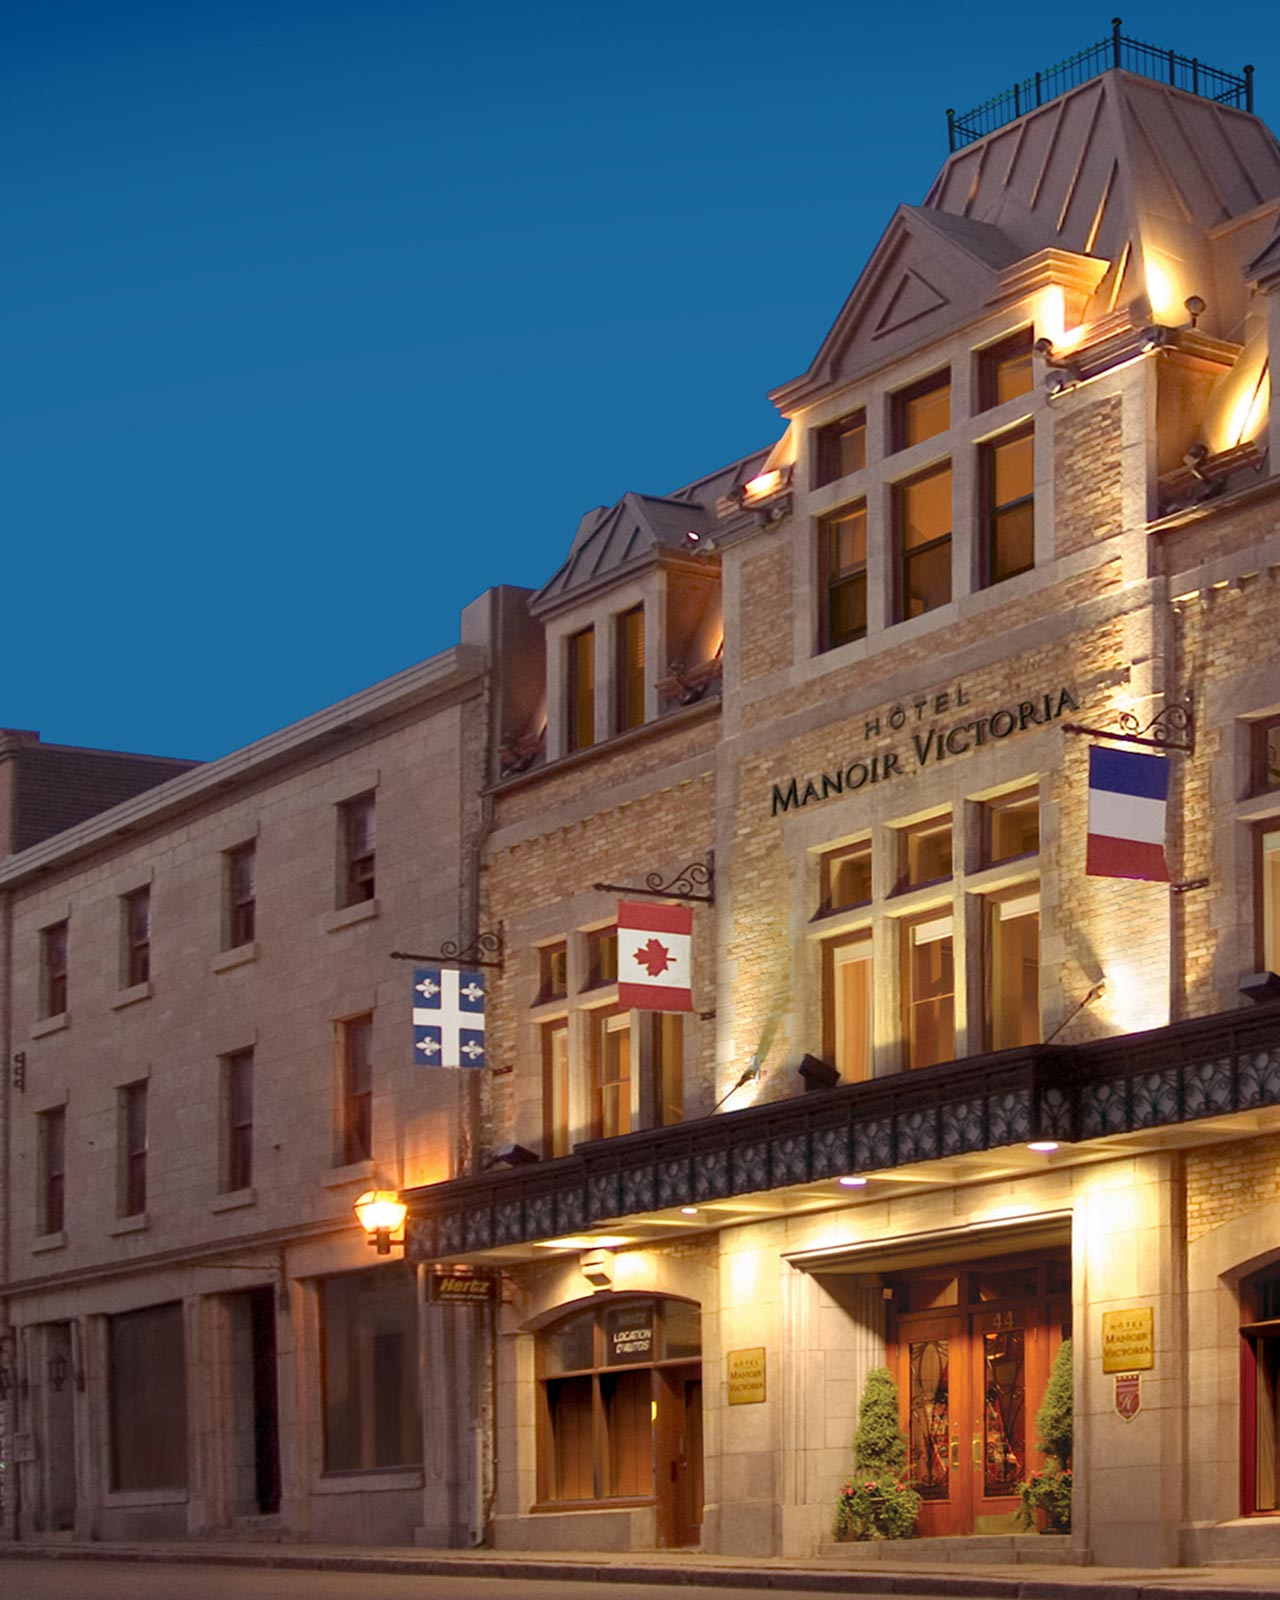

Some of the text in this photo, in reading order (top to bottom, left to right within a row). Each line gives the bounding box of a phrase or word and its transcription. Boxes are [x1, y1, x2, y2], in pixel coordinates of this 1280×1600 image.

[771, 687, 1080, 817] MANOIR VICTORIA
[440, 1278, 490, 1293] Hertz
[613, 1329, 652, 1343] LOCATION
